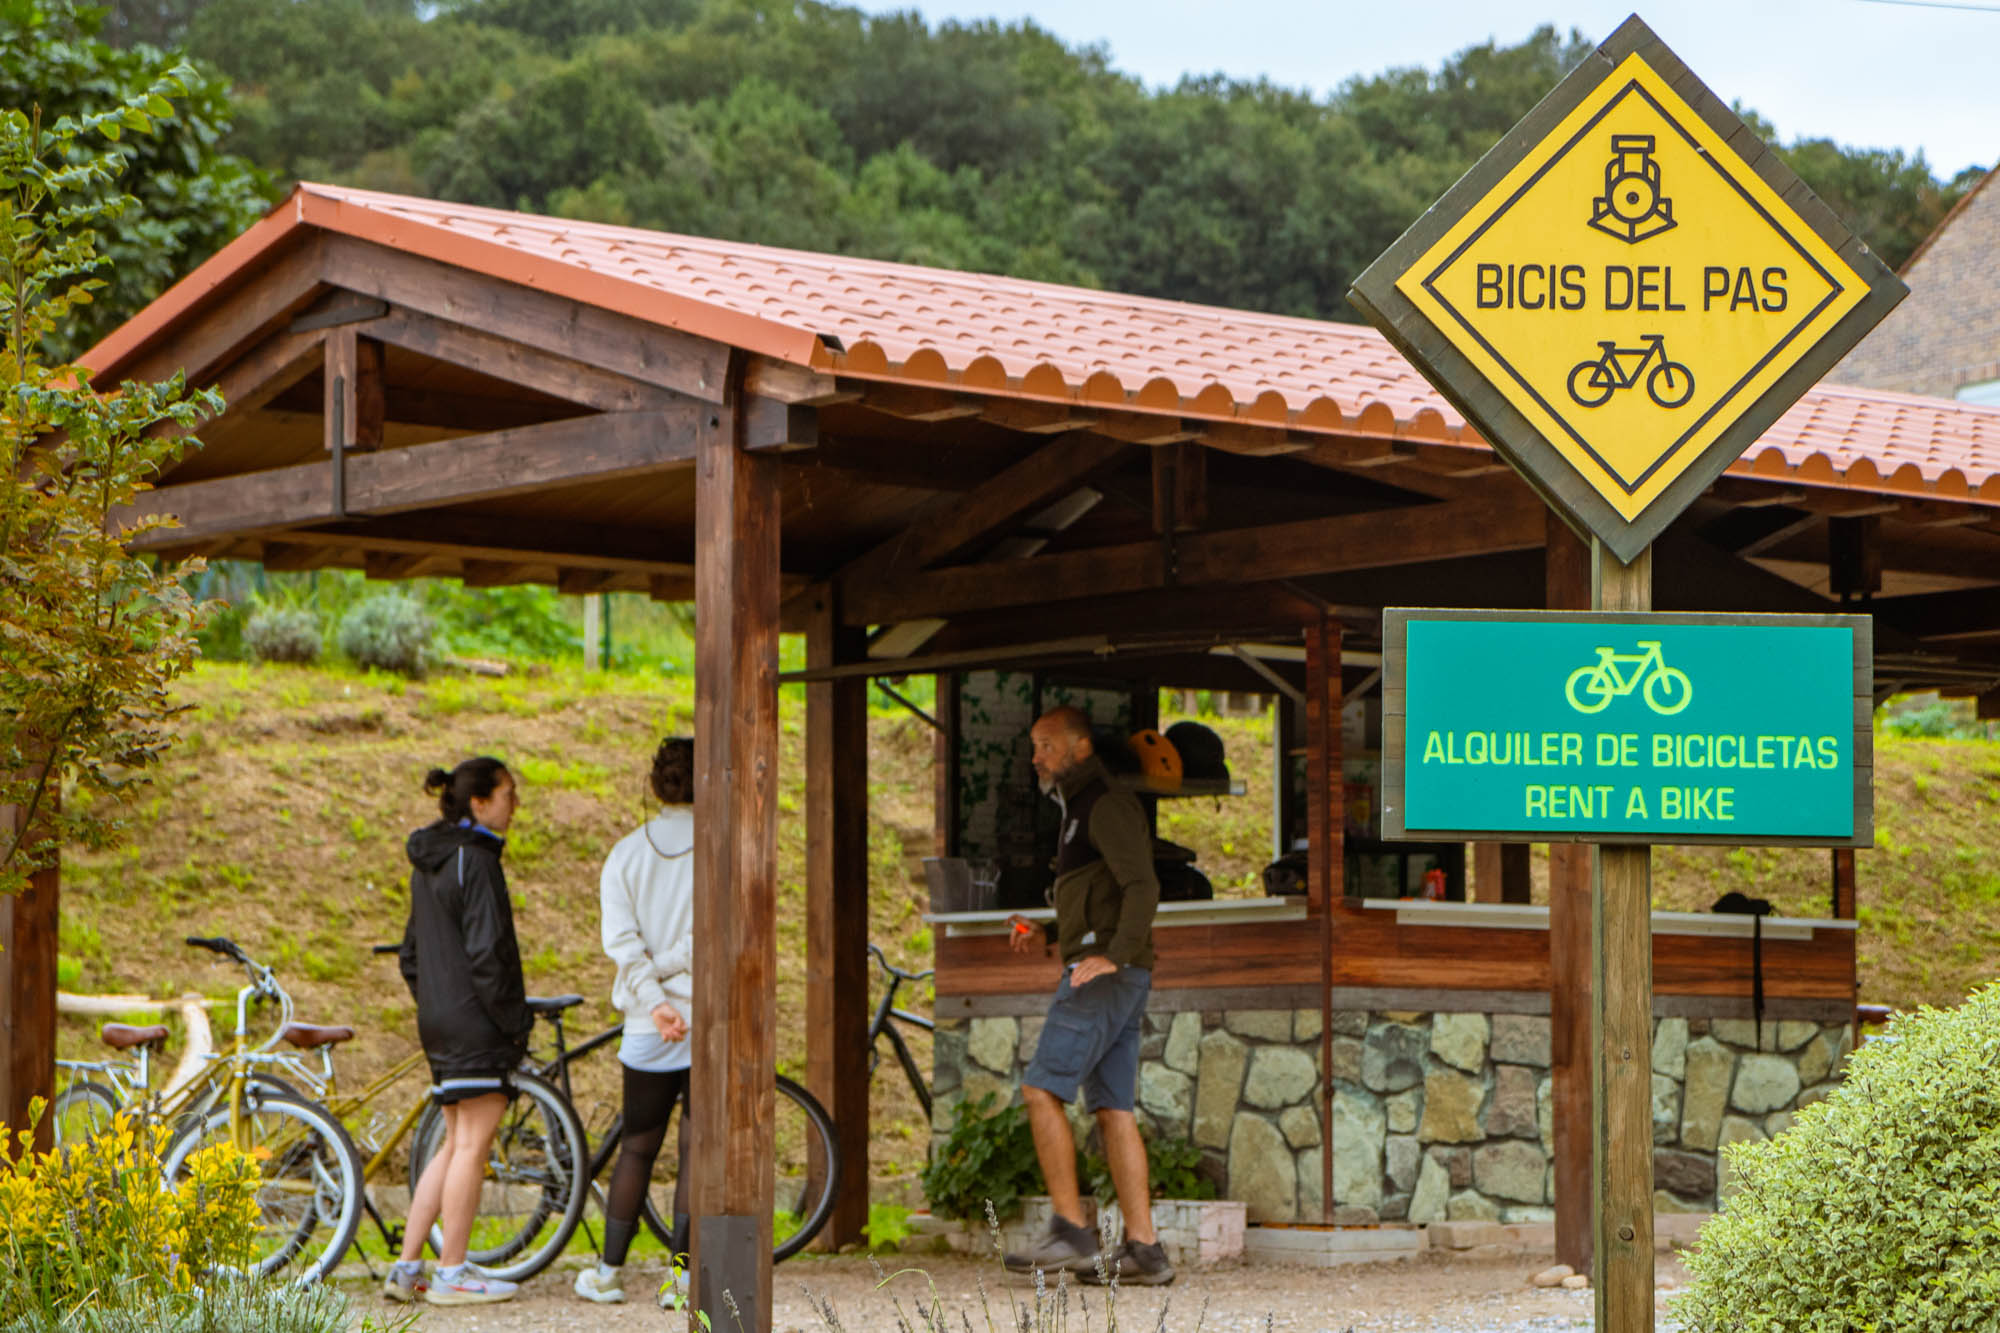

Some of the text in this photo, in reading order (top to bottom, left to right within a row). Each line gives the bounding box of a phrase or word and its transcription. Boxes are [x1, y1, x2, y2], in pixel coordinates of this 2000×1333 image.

[1477, 264, 1787, 312] BICIS DEL PAS
[1424, 731, 1838, 768] ALQUILER DE BICICLETAS
[1526, 785, 1734, 820] RENT A BIKE
